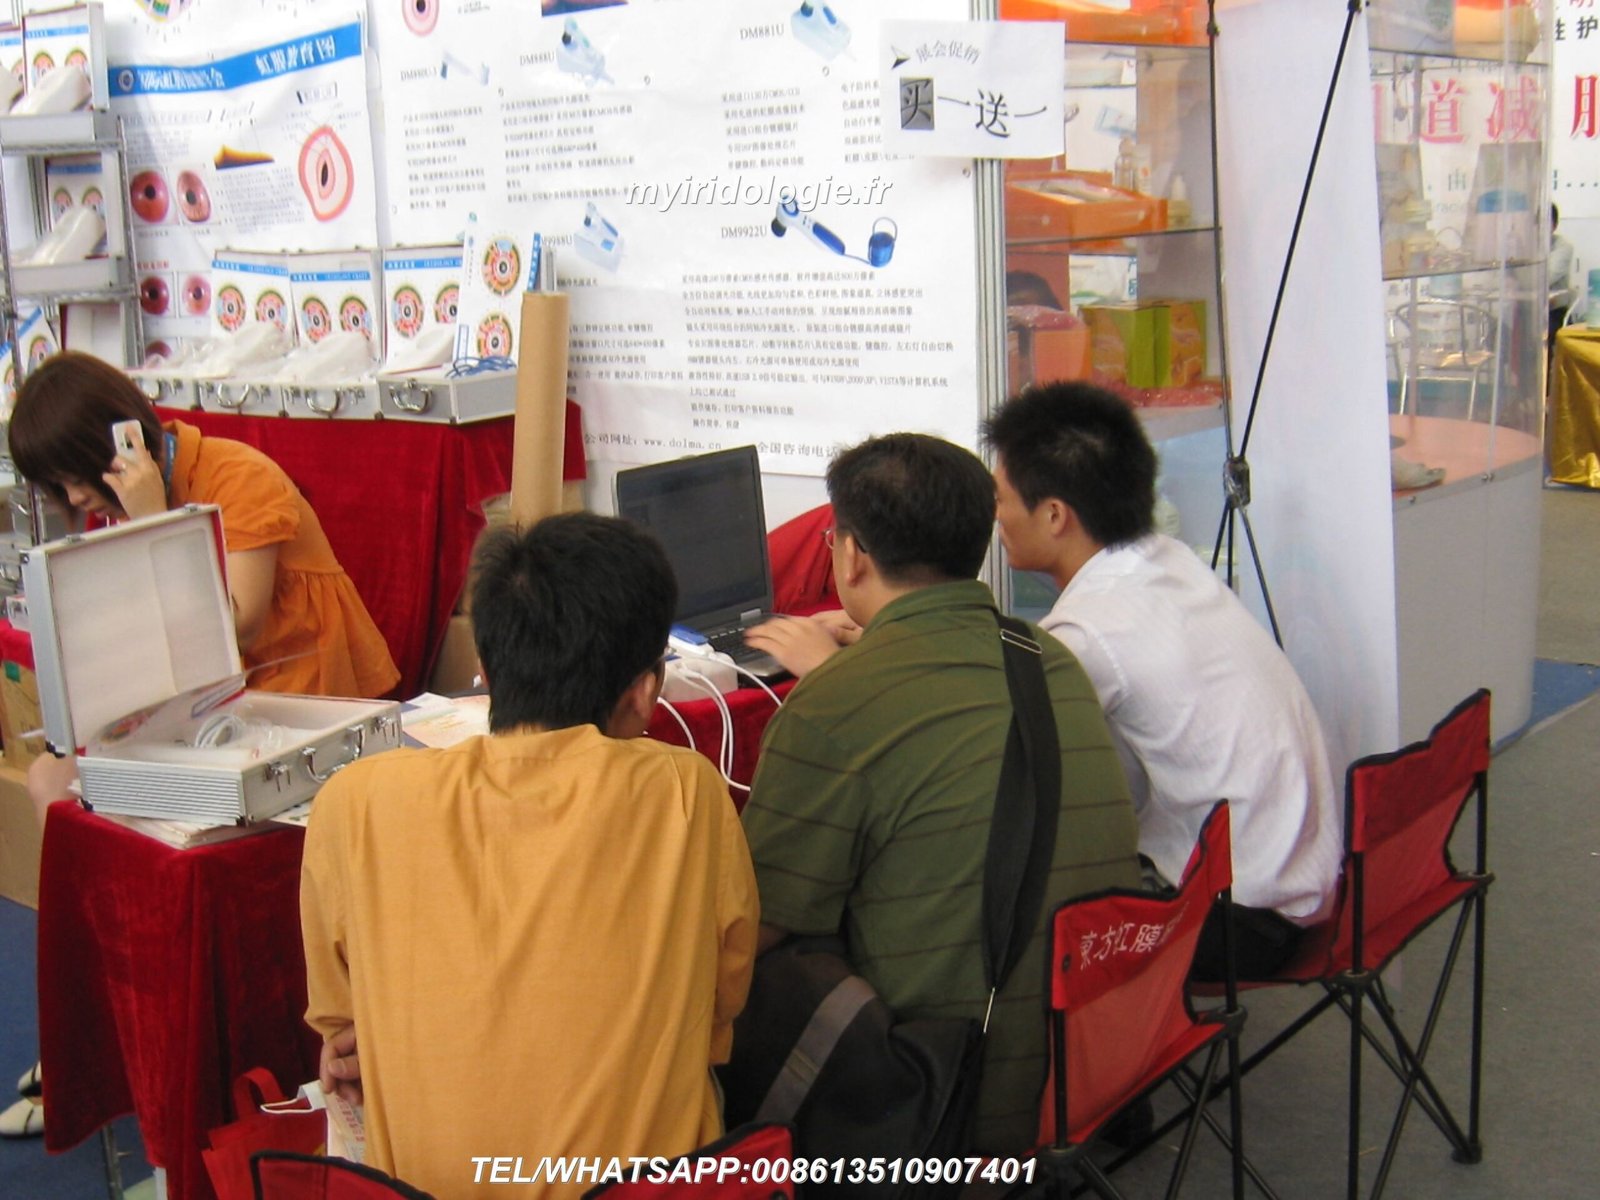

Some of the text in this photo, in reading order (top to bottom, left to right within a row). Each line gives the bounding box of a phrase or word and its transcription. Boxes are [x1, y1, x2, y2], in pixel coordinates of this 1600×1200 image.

[900, 77, 1048, 139] 买一送一
[721, 225, 768, 239] DM9922U
